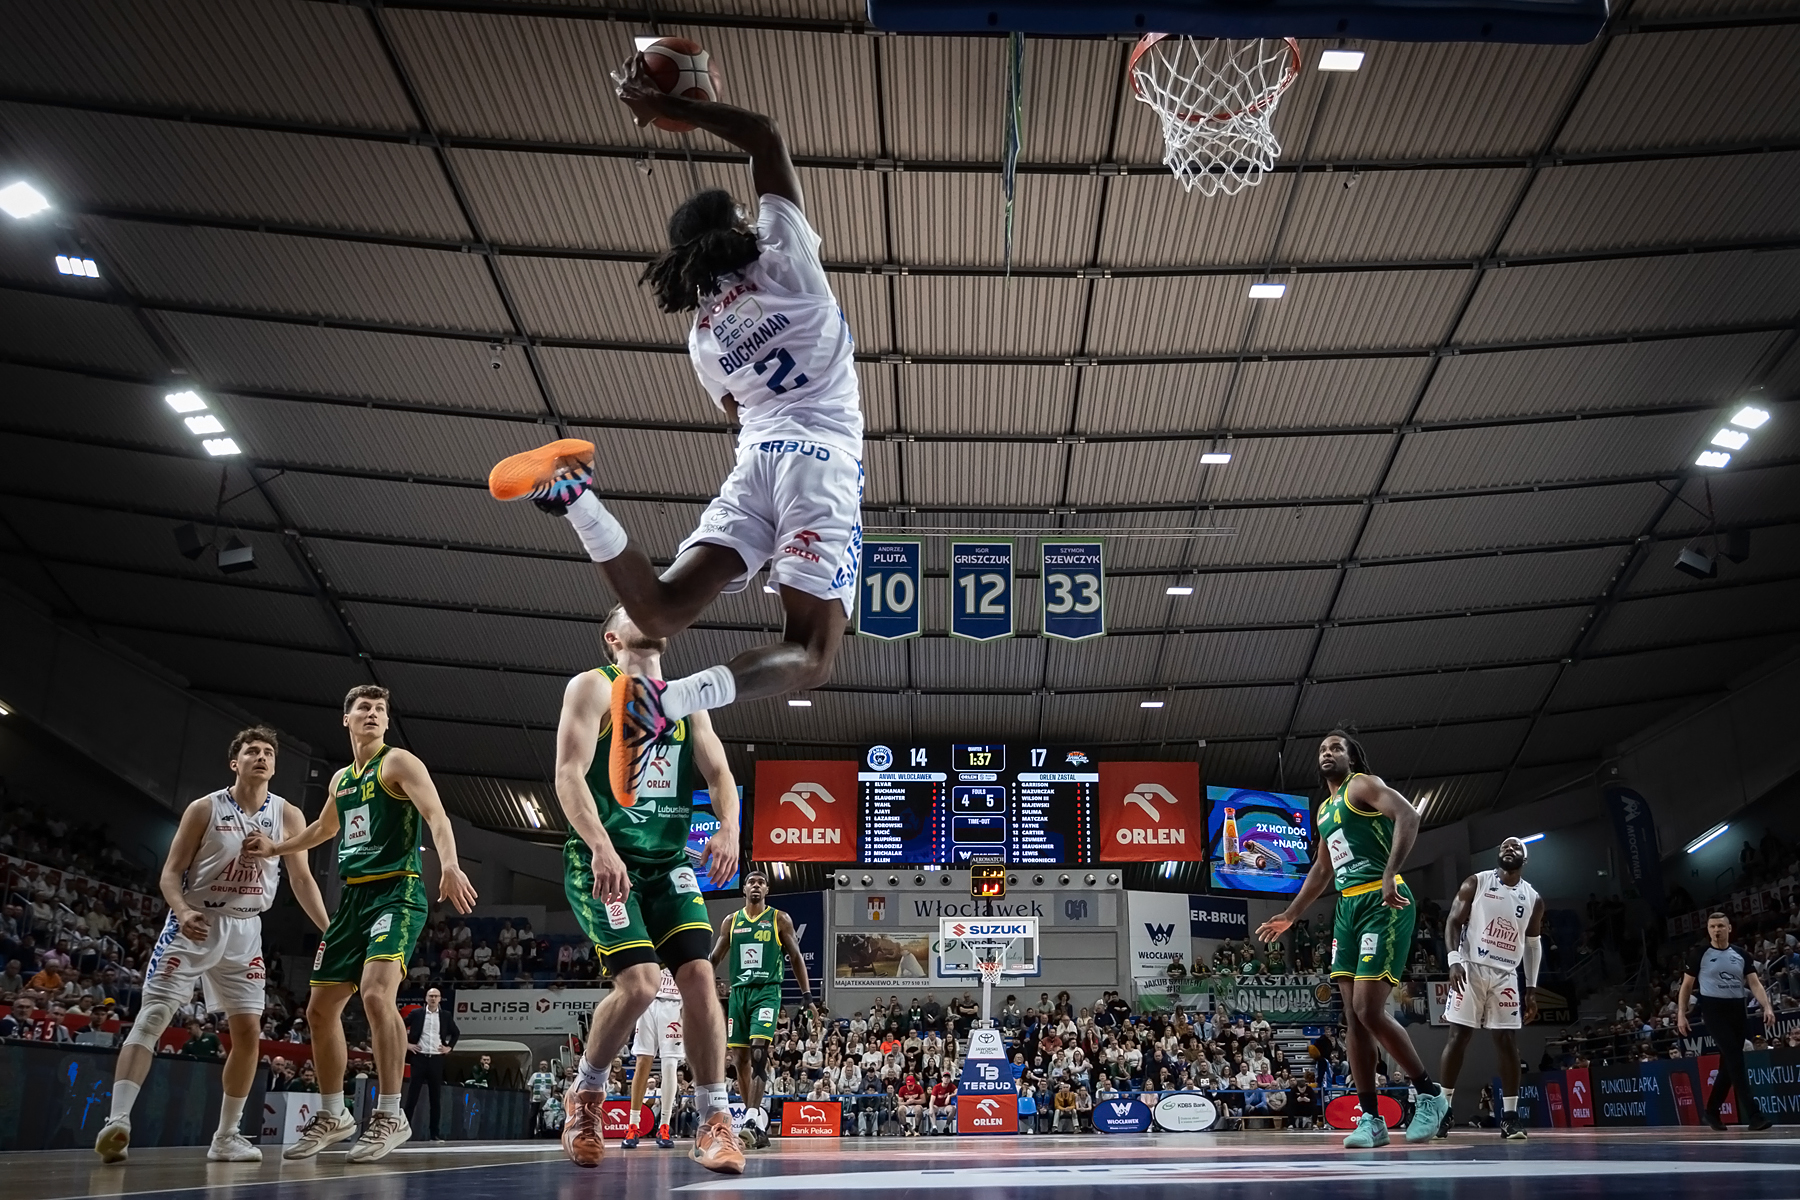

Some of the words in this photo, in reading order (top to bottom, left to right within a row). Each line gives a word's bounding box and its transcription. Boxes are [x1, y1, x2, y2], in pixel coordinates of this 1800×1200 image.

[712, 283, 758, 315] ORLEN
[714, 314, 737, 340] pre
[722, 318, 754, 347] zero
[718, 313, 790, 375] BUCHANAN
[753, 348, 809, 395] 2
[750, 440, 830, 461] ERBUD
[784, 546, 820, 563] ORLEN
[955, 556, 1010, 564] GRISZCZUK
[1045, 556, 1100, 564] SZEWCZYK
[866, 572, 914, 612] 10
[959, 573, 1005, 614] 12
[1047, 573, 1100, 613] 33
[910, 748, 927, 766] 14
[969, 753, 991, 766] 1:37
[1030, 748, 1047, 767] 17
[361, 781, 375, 802] 12
[647, 780, 670, 788] ORLEN
[962, 794, 970, 807] 4
[986, 794, 994, 807] 5
[1334, 808, 1342, 824] 4
[696, 821, 714, 832] HOT
[1256, 824, 1267, 832] 2X
[1269, 824, 1286, 834] HOT
[1288, 827, 1306, 836] DOG
[349, 830, 366, 840] ORLEN
[770, 828, 840, 845] ORLEN
[1117, 828, 1185, 845] ORLEN
[1273, 839, 1307, 850] +NAPÓJ
[914, 899, 1044, 917] Włocławek
[1516, 906, 1525, 918] 9
[1190, 910, 1246, 925] ER-BRUK
[754, 930, 771, 942] 40
[970, 925, 1026, 934] SUZUKI
[1483, 918, 1518, 943] Anwil
[1481, 937, 1496, 946] GRUPA
[1497, 942, 1516, 951] ORLEN
[1138, 952, 1183, 960] WŁOCŁAWEK
[1144, 978, 1167, 989] JAKUB
[1237, 976, 1312, 986] ZASTAL
[470, 1001, 529, 1013] Larisa
[1237, 990, 1262, 1012] ON
[1265, 989, 1315, 1013] TOUR
[1747, 1065, 1795, 1085] PUNKTUJ
[1601, 1078, 1632, 1094] PUNKTUJ
[1632, 1077, 1637, 1092] Z
[1639, 1076, 1660, 1095] APKĄ
[1573, 1109, 1590, 1118] ORLEN
[1604, 1103, 1627, 1118] ORLEN
[1627, 1102, 1646, 1116] VITAY
